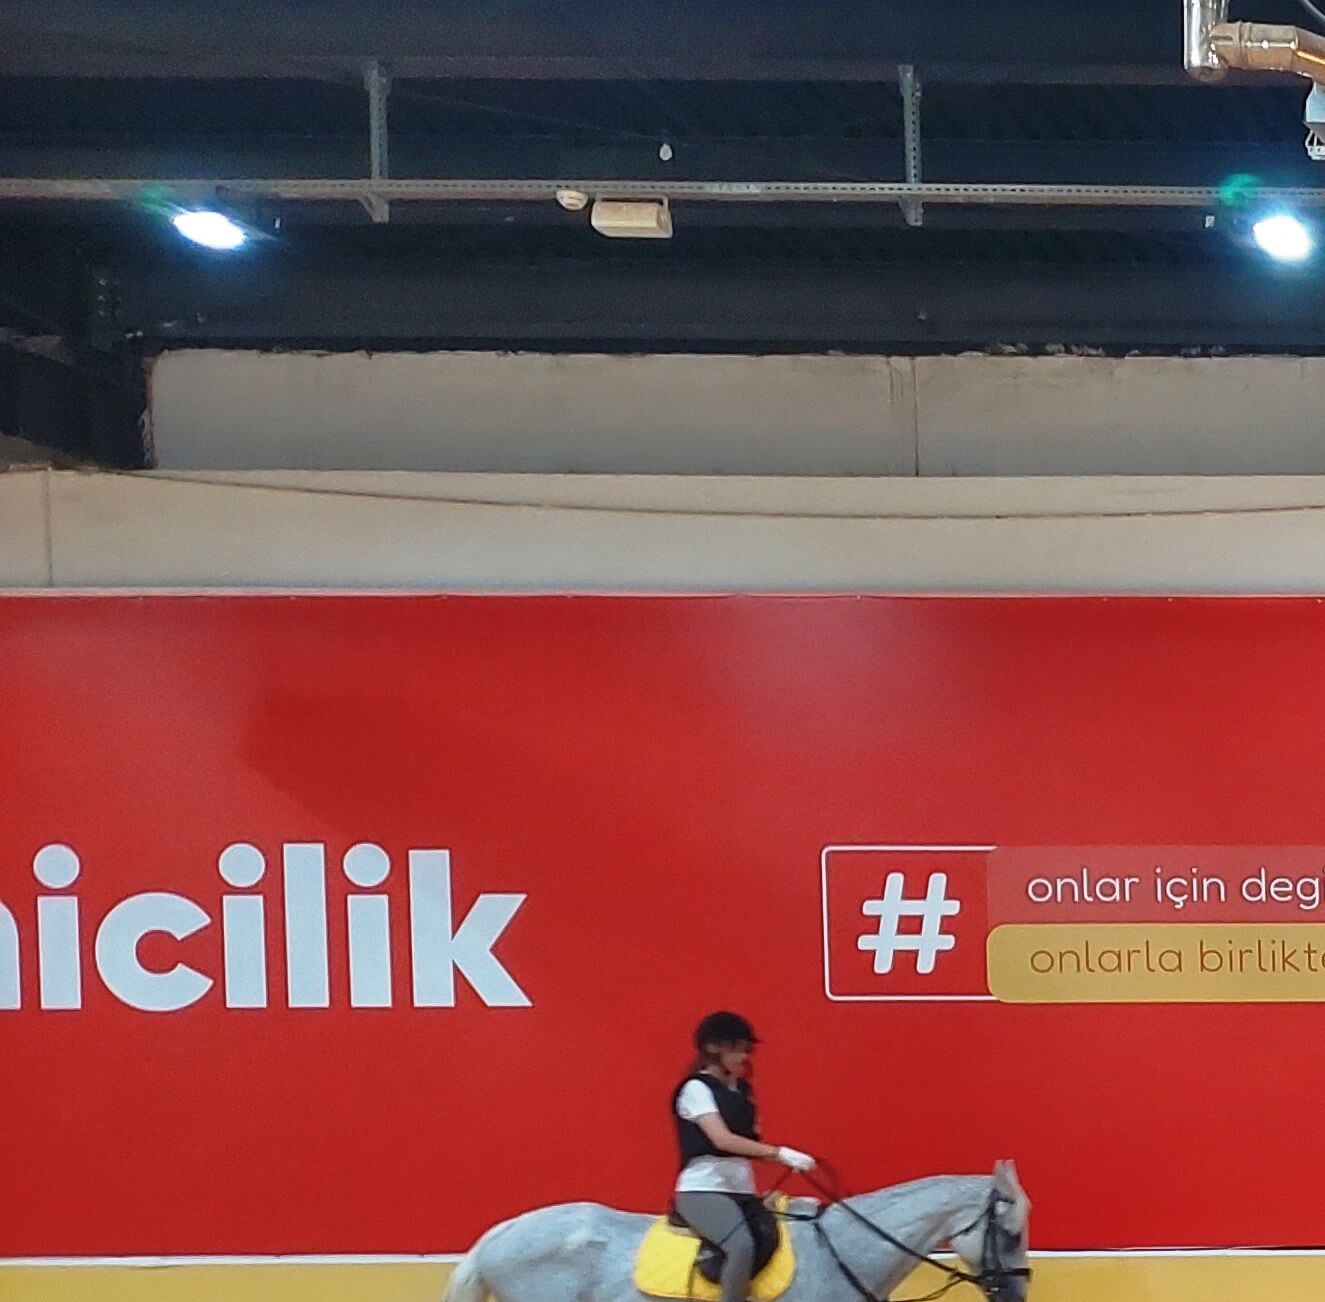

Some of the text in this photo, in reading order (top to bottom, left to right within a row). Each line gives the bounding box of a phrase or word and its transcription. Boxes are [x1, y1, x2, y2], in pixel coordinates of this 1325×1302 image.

[856, 871, 961, 974] #
[1027, 869, 1139, 904] onlar
[1154, 867, 1225, 911] için
[0, 842, 533, 1012] icilik
[1029, 940, 1183, 975] onlarla
